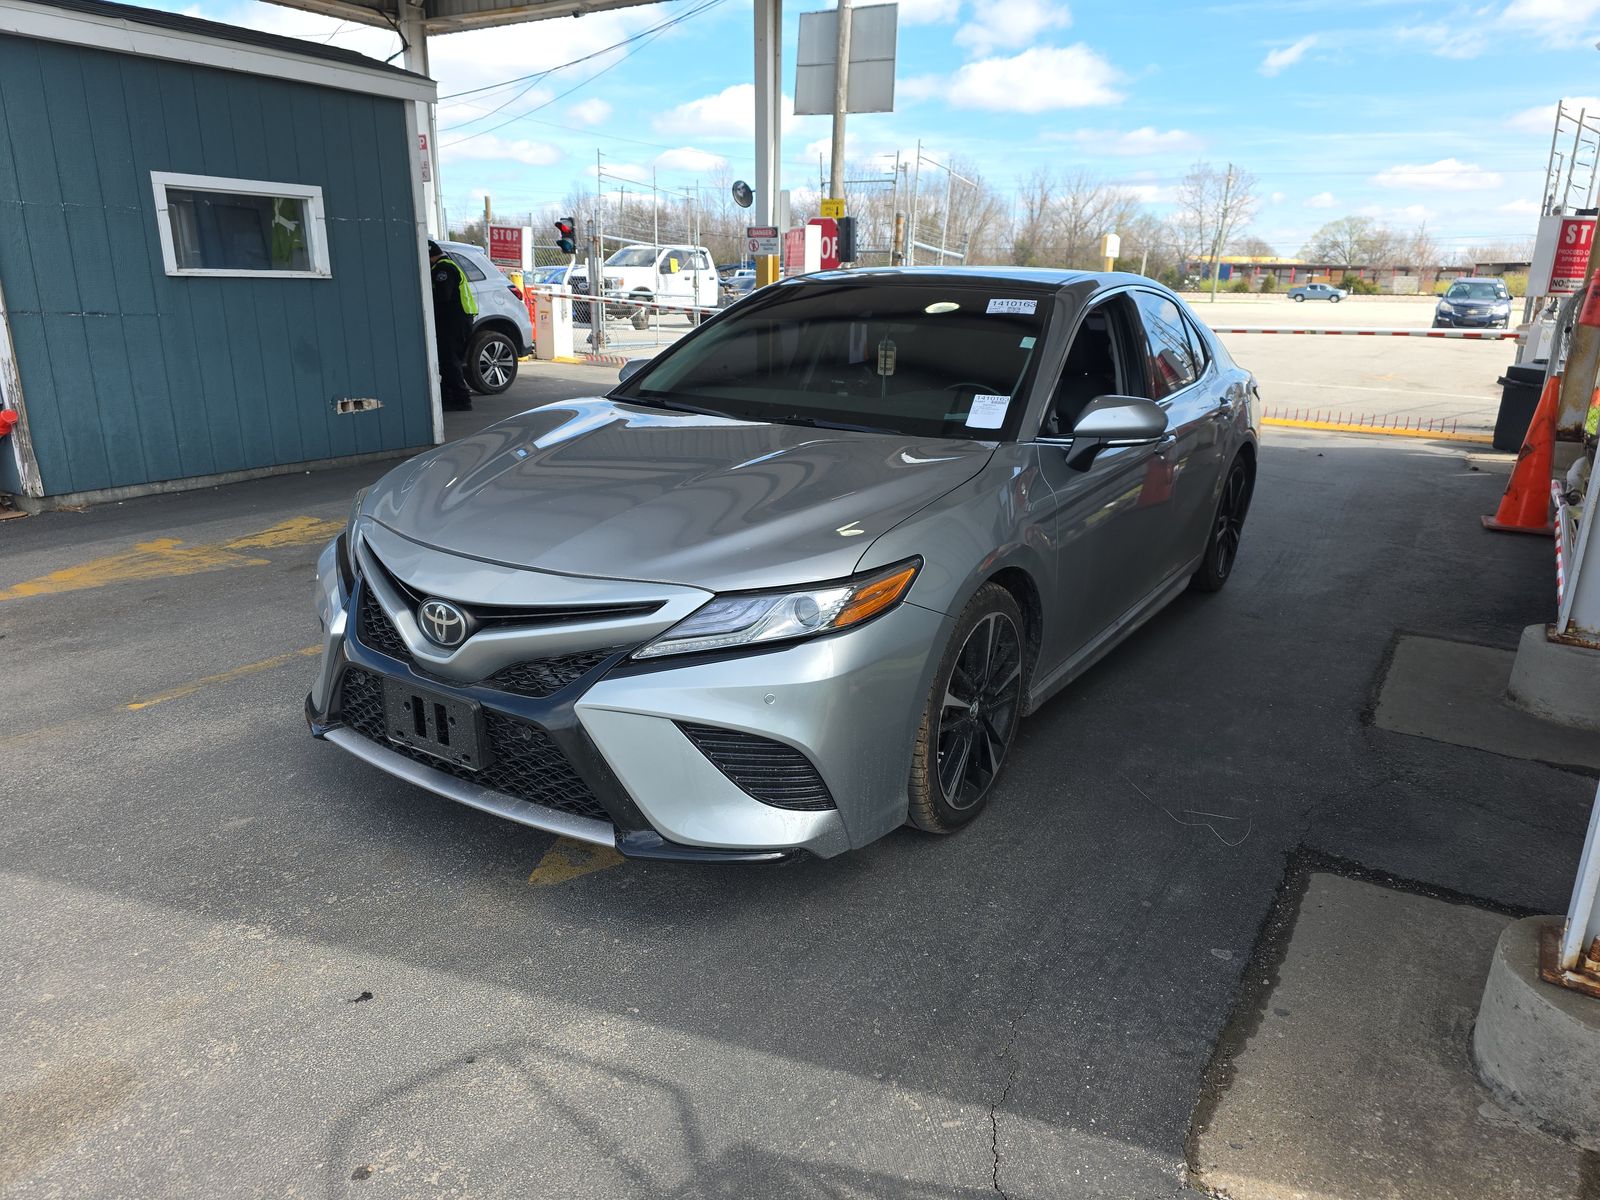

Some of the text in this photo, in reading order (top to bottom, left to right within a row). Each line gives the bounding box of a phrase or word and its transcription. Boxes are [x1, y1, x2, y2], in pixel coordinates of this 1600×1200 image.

[493, 229, 518, 241] STOP
[1566, 224, 1596, 244] ST
[1552, 279, 1564, 287] NO
